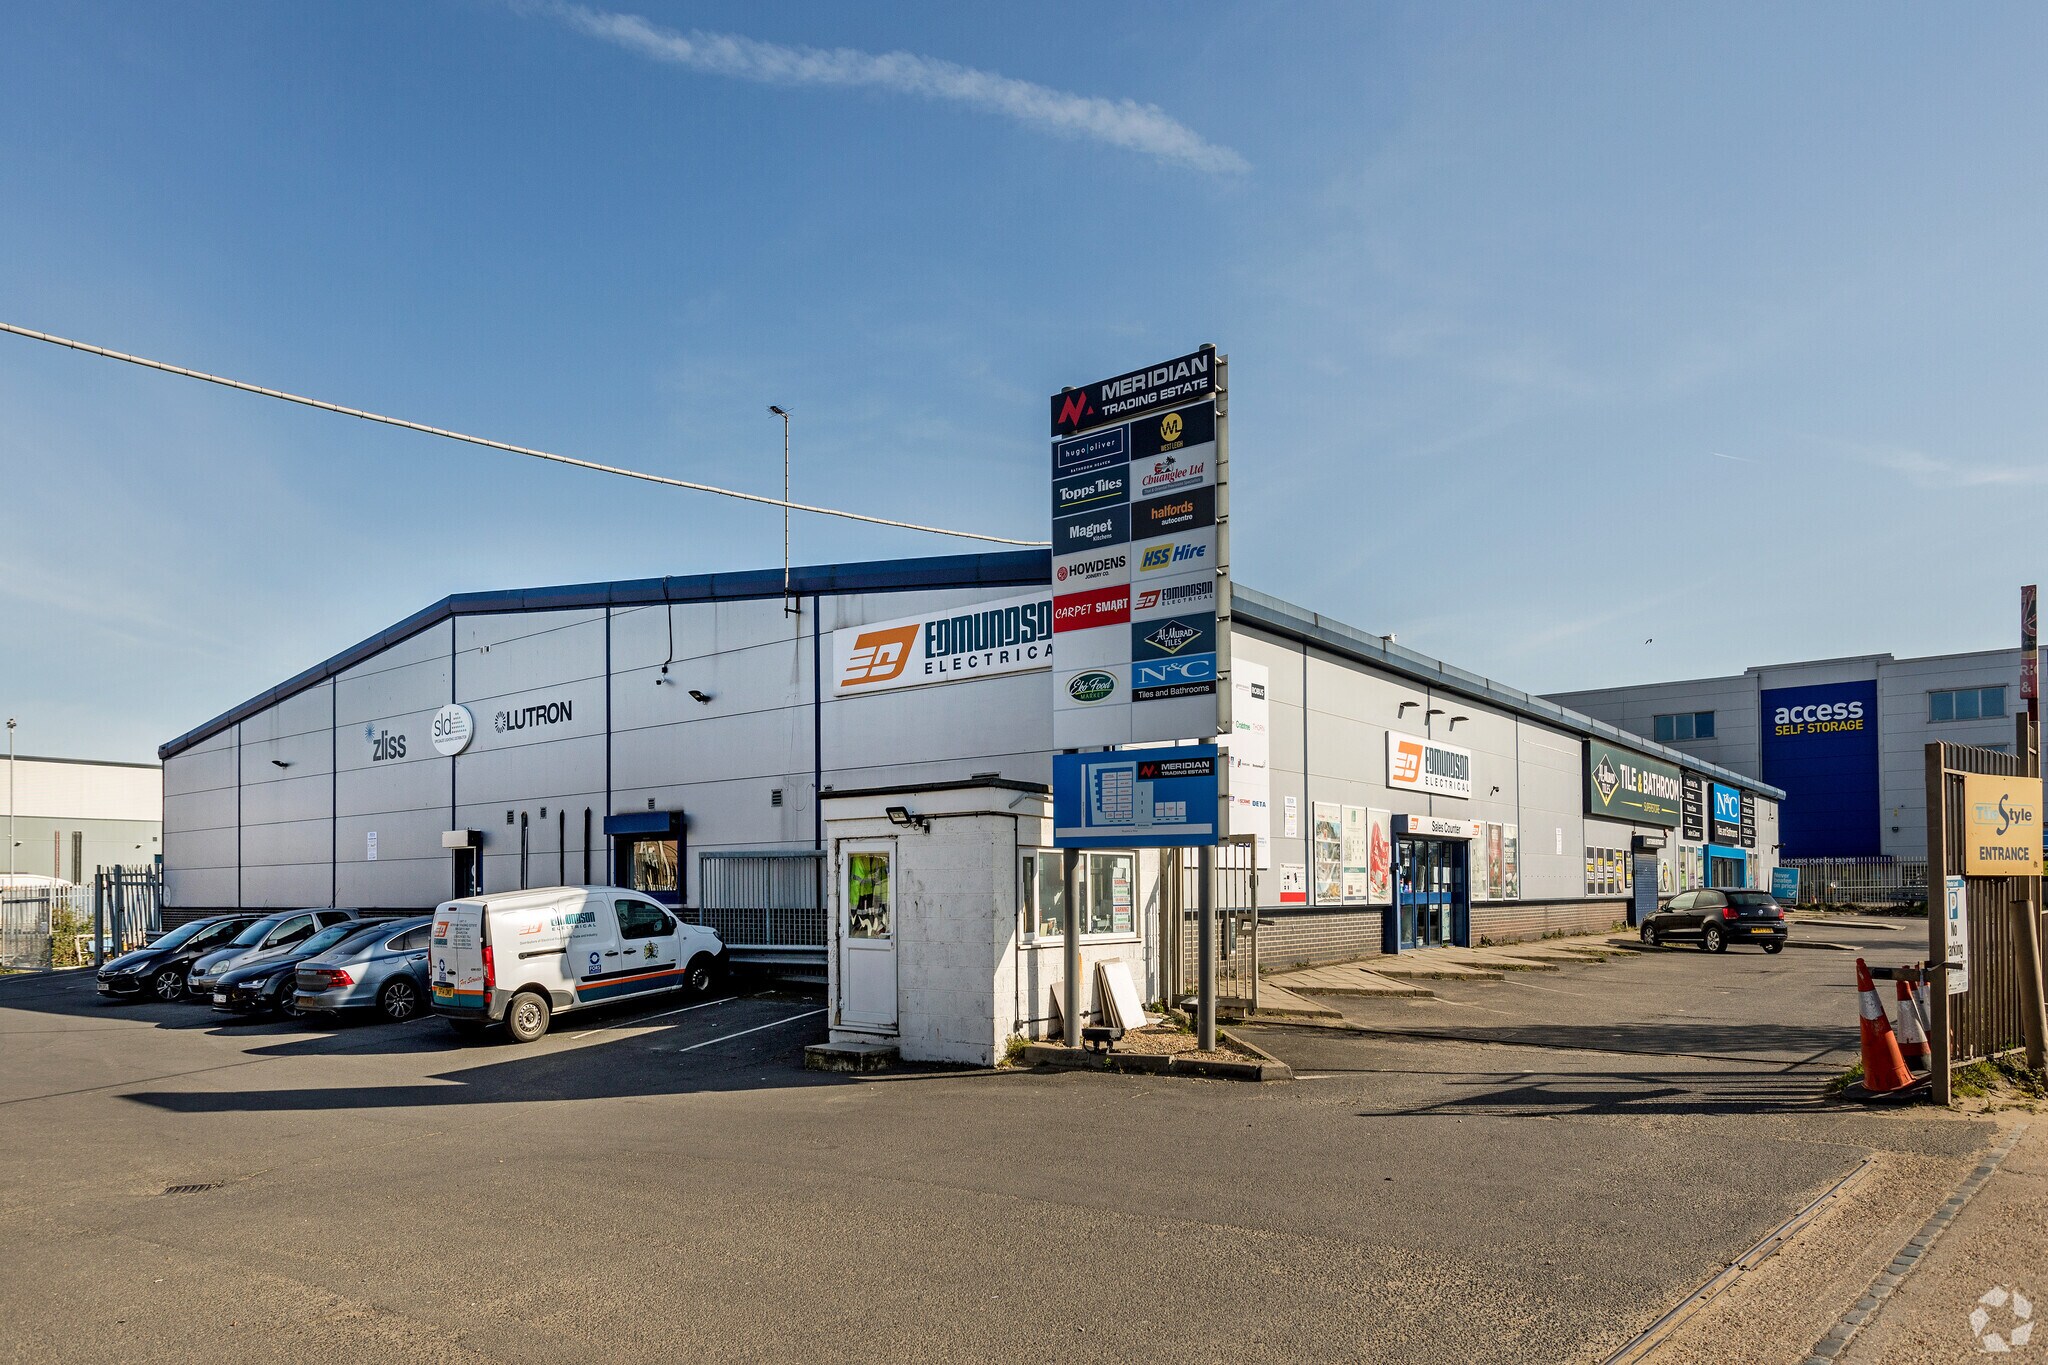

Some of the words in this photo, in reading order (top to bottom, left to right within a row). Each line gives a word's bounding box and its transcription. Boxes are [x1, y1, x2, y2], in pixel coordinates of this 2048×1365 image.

[1102, 354, 1208, 401] MERIDIAN
[1102, 392, 1157, 415] TRADING
[1160, 377, 1208, 400] ESTATE
[1142, 469, 1188, 486] Chuanglee
[1189, 462, 1204, 475] Ltd
[1060, 485, 1095, 500] Topps
[1095, 479, 1122, 494] Tiles
[1151, 501, 1193, 519] halfords
[1069, 518, 1112, 539] Magnet
[1092, 533, 1113, 542] Kitchens
[1069, 555, 1126, 577] HOWDENS
[1143, 548, 1171, 567] HSS
[1173, 544, 1206, 562] Hire
[1162, 580, 1213, 600] EDMUNDSON
[1162, 594, 1213, 606] ELECTRICAL
[1055, 603, 1092, 619] CARPET
[1095, 598, 1129, 613] SMART
[925, 600, 1053, 659] EDMUNDSO
[1164, 639, 1181, 647] TILES
[925, 643, 1053, 675] ELECTRICA
[1138, 660, 1210, 684] N&C
[1089, 676, 1112, 693] Food
[1138, 690, 1154, 698] Tiles
[1155, 688, 1169, 697] and
[1170, 684, 1210, 695] Bathrooms
[506, 700, 572, 731] LUTRON
[1774, 701, 1864, 724] access
[1775, 723, 1805, 736] SELF
[1807, 719, 1864, 733] STORAGE
[373, 730, 406, 761] zliss
[1161, 761, 1210, 770] MERIDIAN
[1425, 746, 1469, 781] EDMUNDSON
[1425, 776, 1470, 792] ELECTRICAL
[1620, 764, 1637, 792] TILE
[1638, 773, 1643, 793] &
[1643, 770, 1680, 802] BATHROOM
[1716, 792, 1738, 818] N&C
[1431, 820, 1444, 832] Sales
[1444, 822, 1461, 834] Counter
[1979, 846, 2030, 861] ENTRANCE
[551, 923, 597, 932] ELECTRICAL
[1950, 922, 1958, 937] No
[1949, 941, 1963, 959] arking
